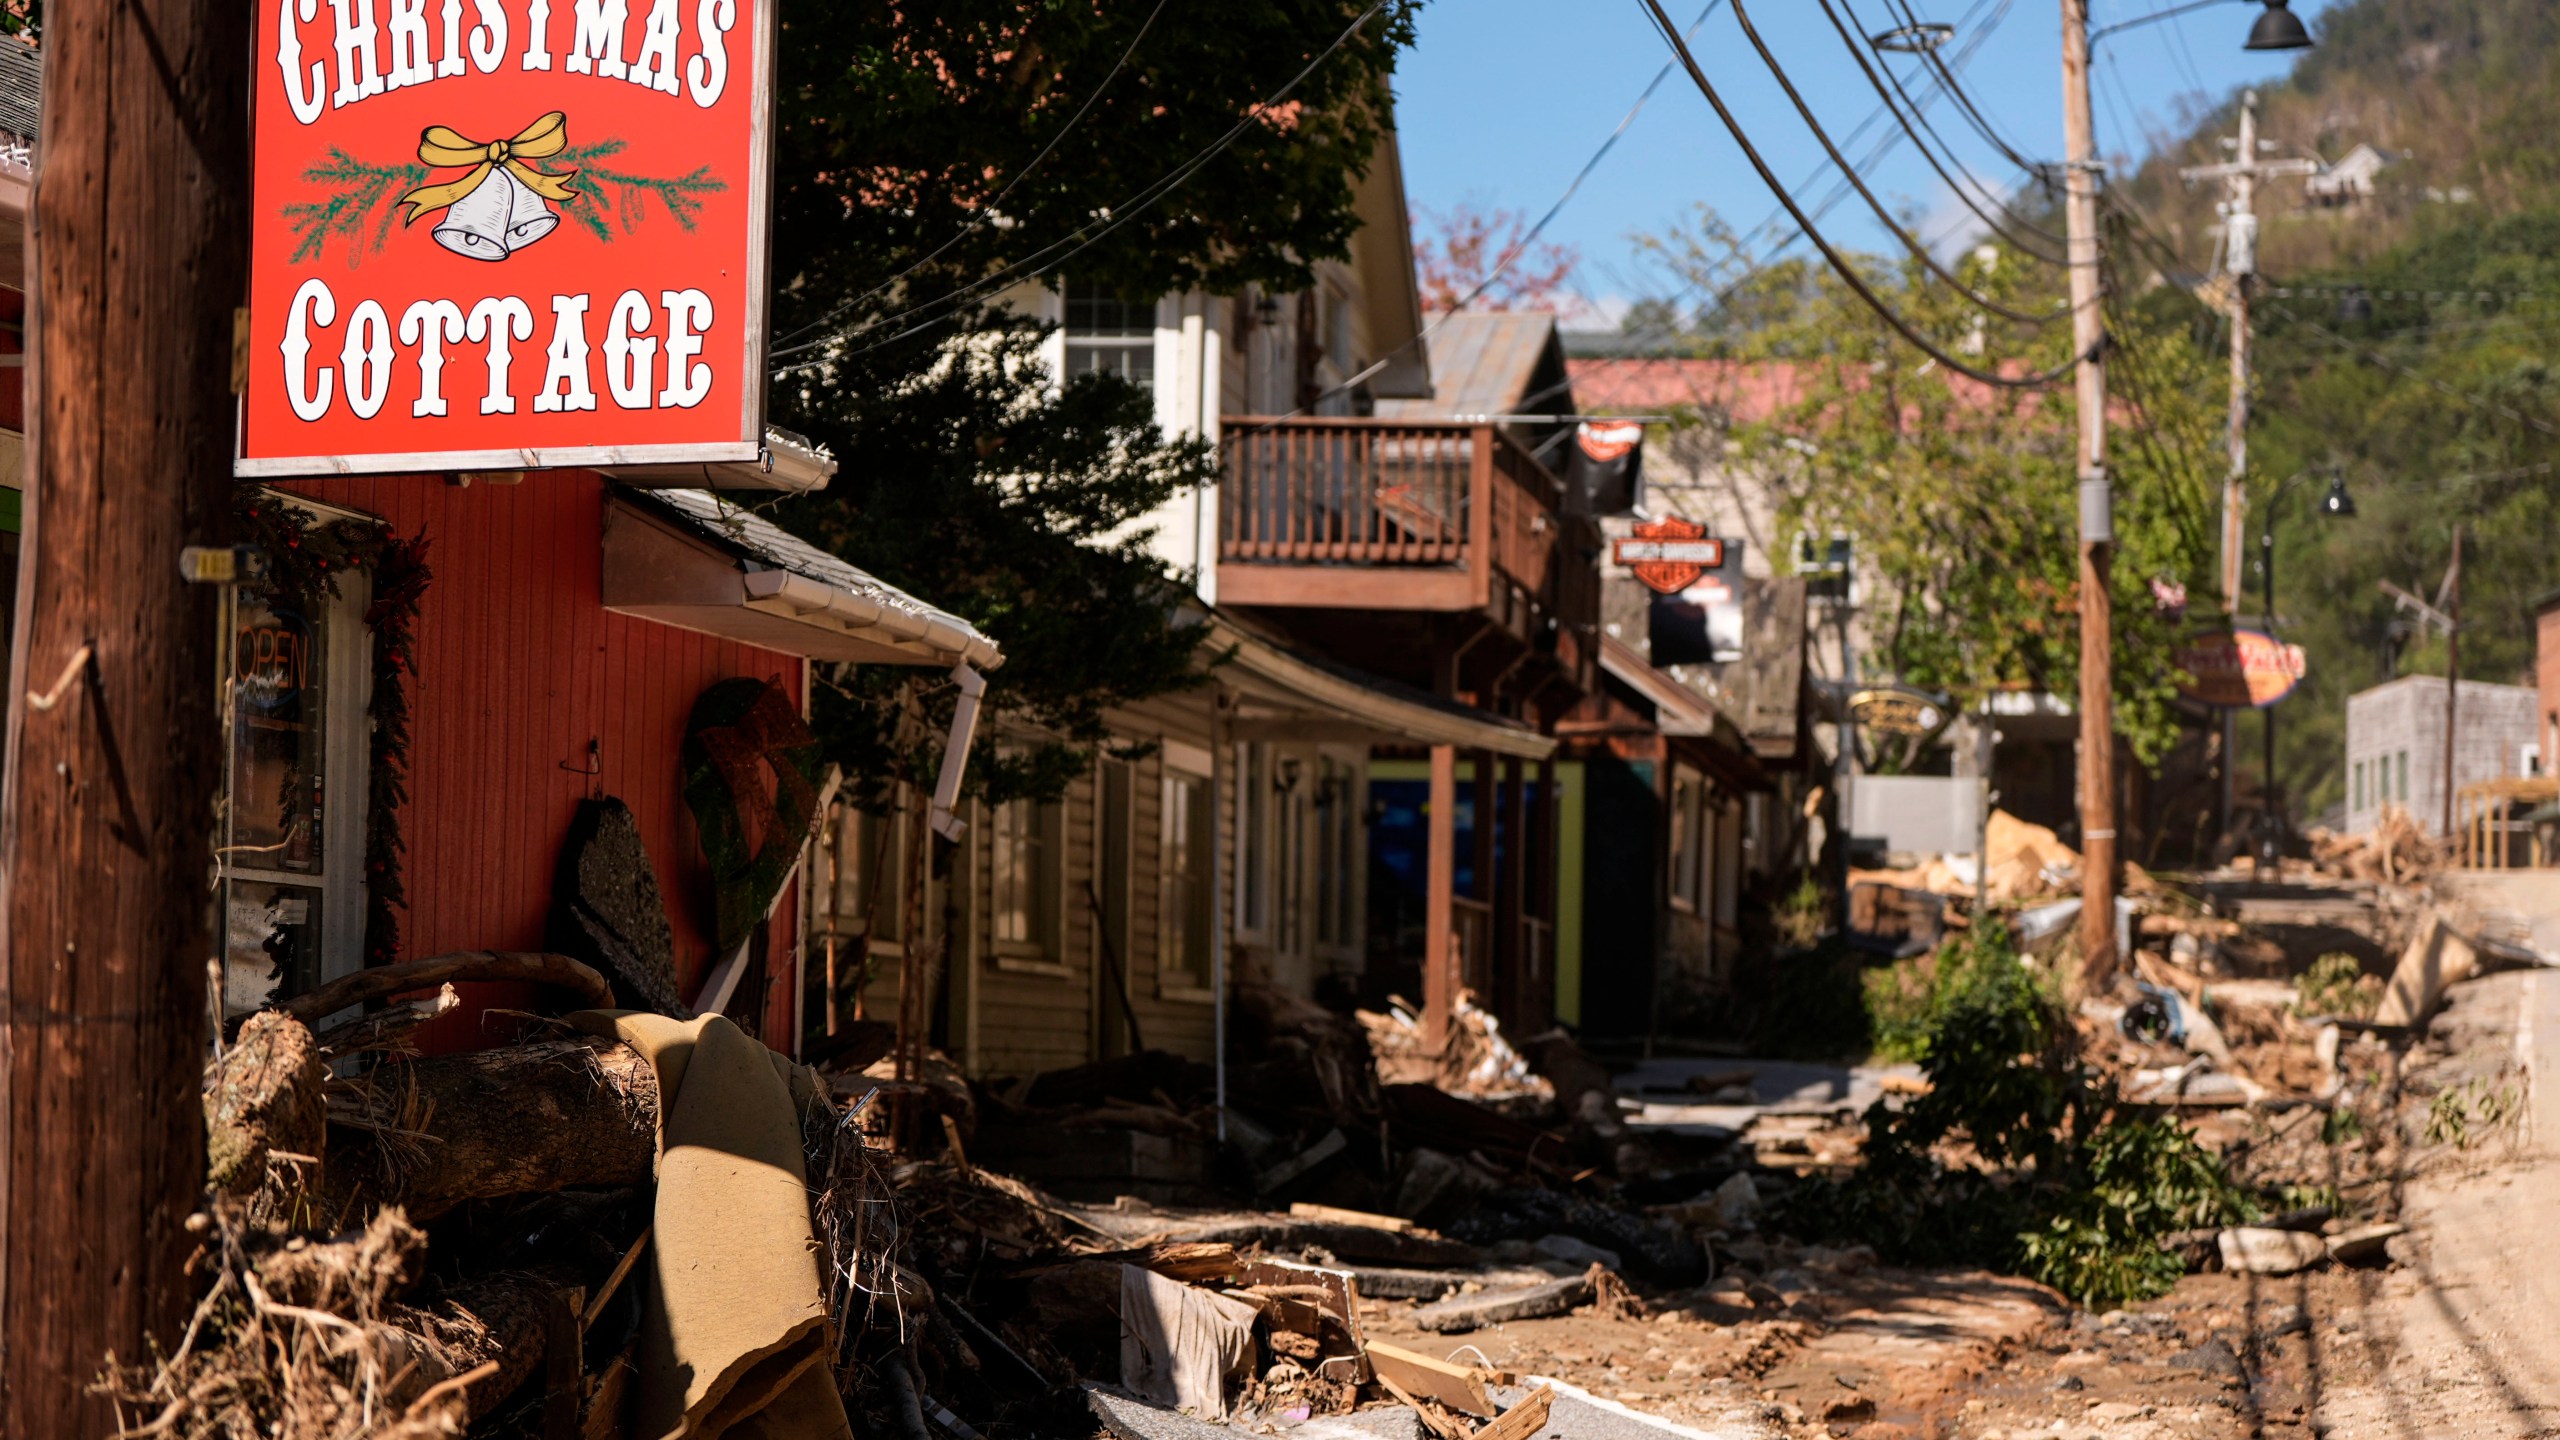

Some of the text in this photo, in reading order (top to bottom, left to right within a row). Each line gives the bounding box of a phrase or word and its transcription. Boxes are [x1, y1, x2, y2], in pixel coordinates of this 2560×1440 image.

[276, 0, 737, 125] CHRISTMAS
[279, 278, 714, 422] COTTAGE
[237, 626, 308, 690] OPEN
